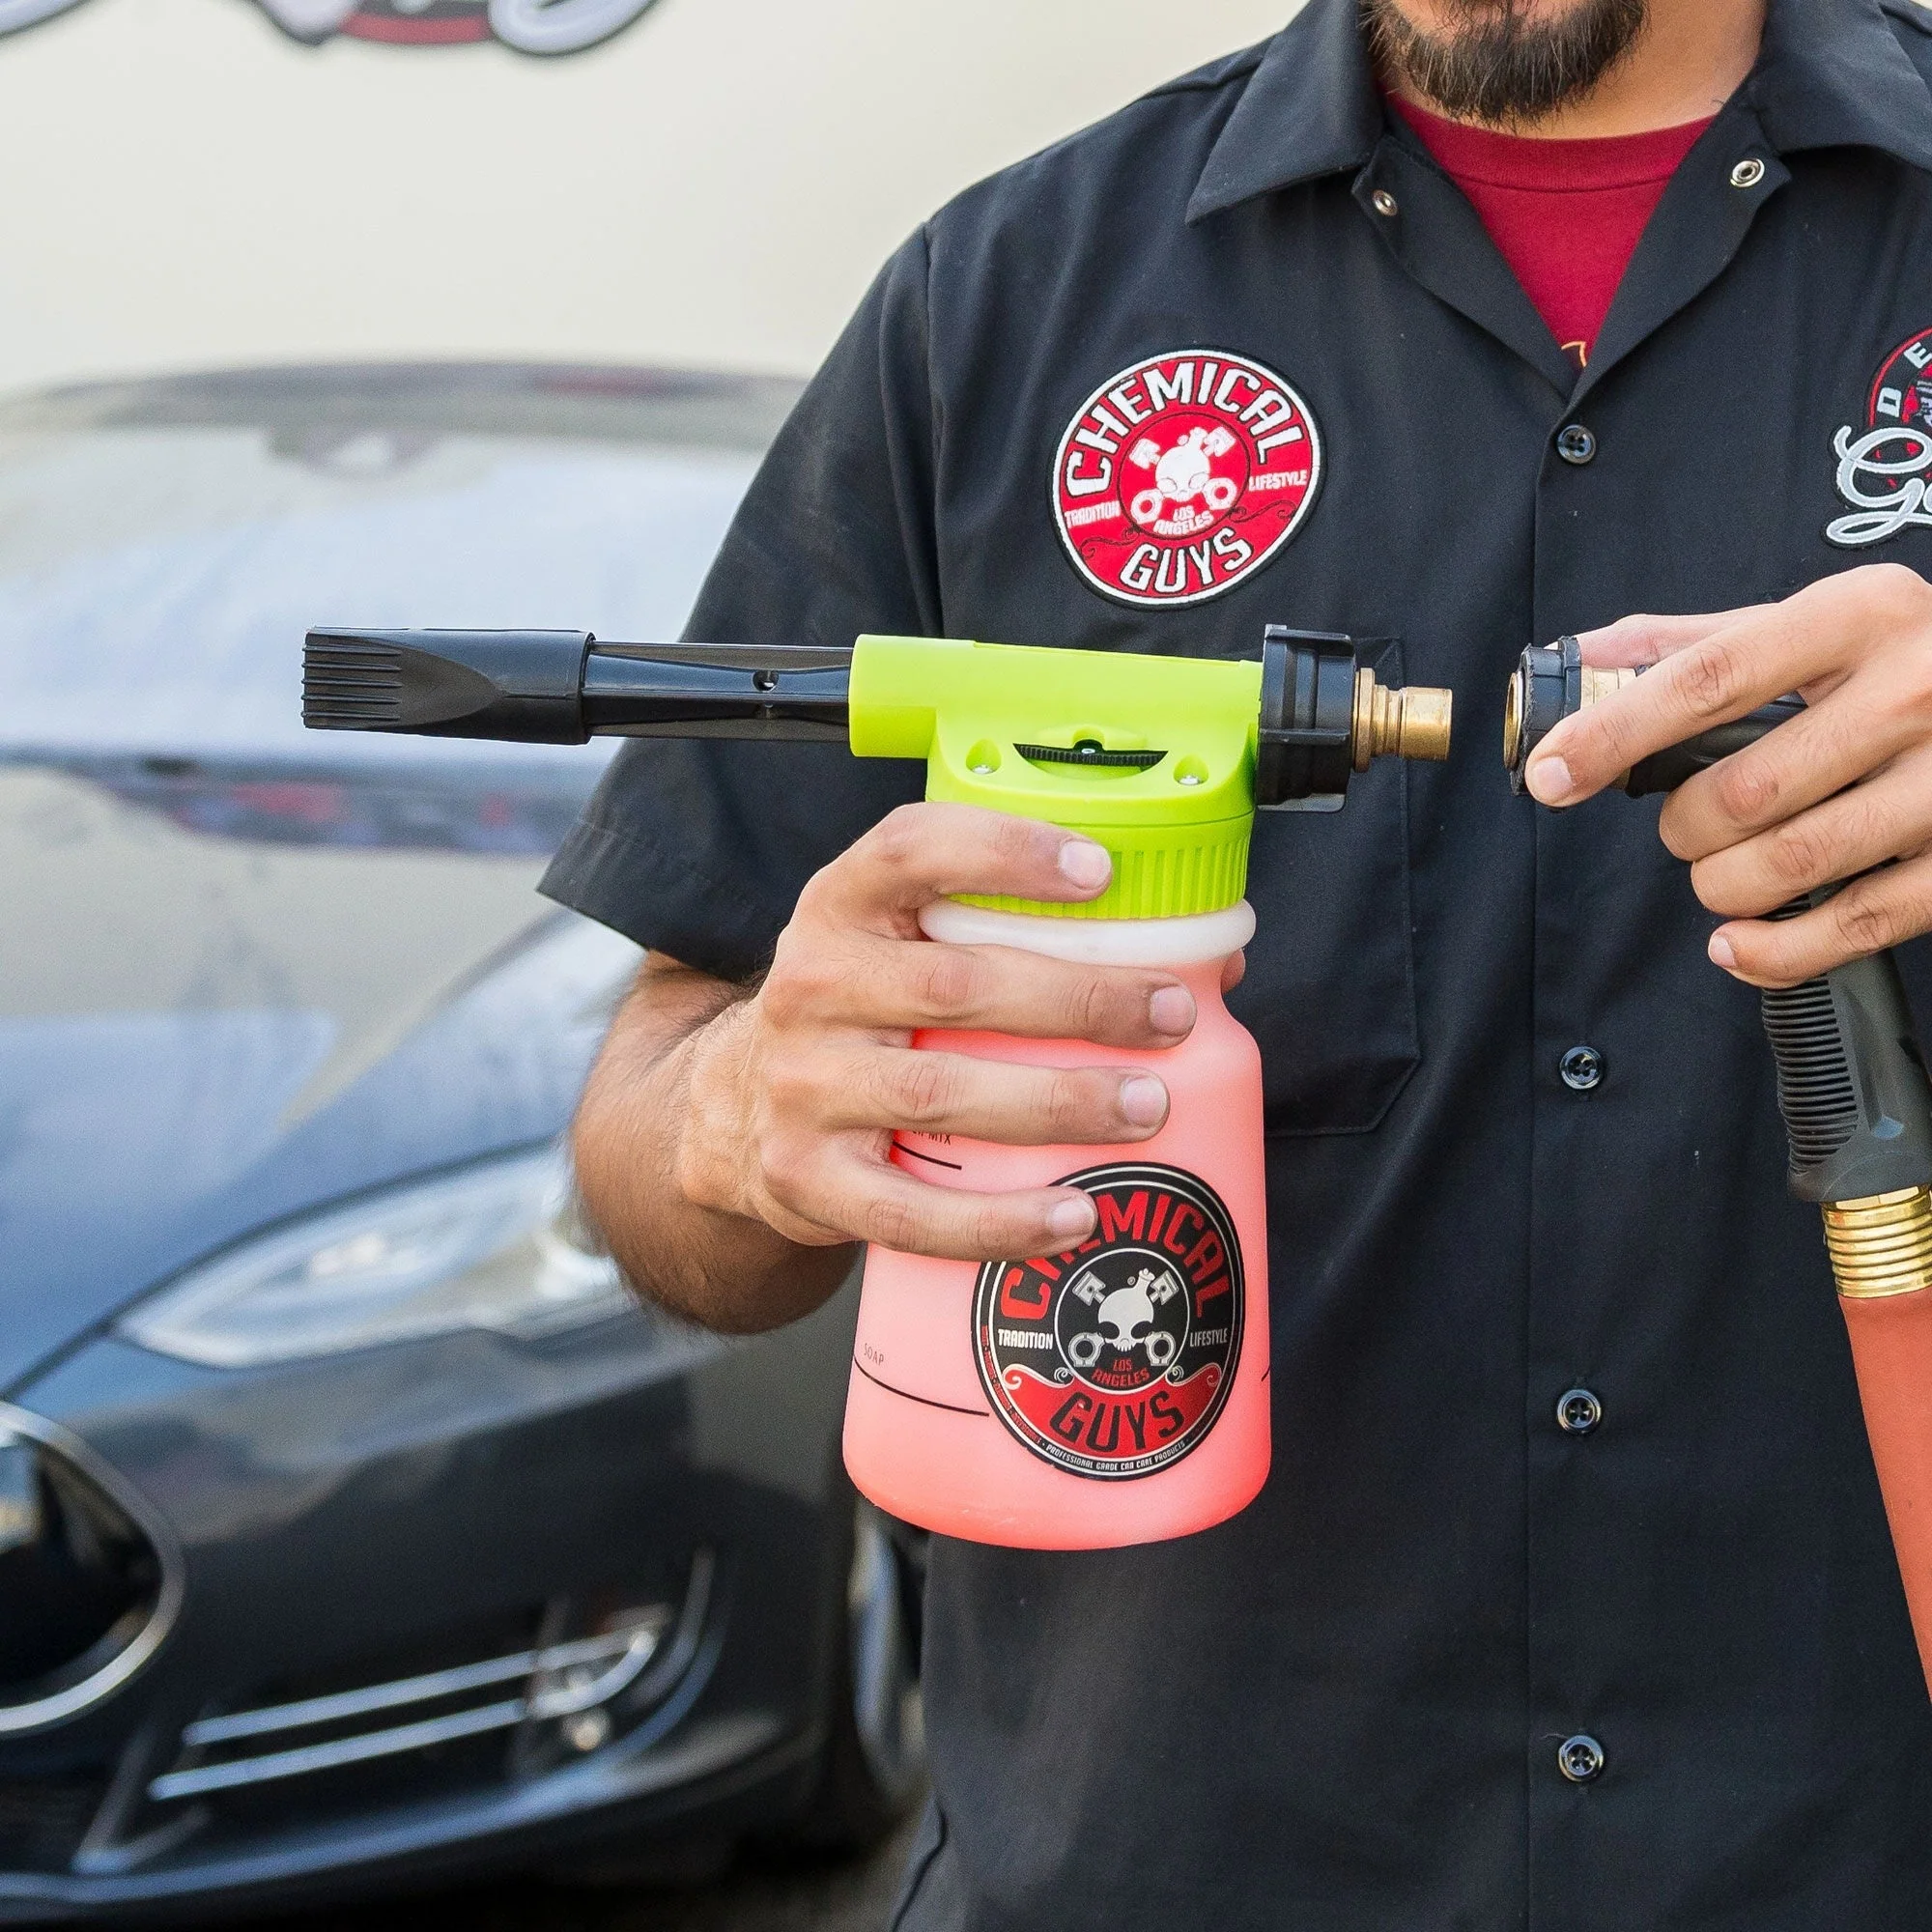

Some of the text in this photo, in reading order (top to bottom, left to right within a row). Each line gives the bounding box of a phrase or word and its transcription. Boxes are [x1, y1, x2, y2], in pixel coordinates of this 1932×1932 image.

[1065, 361, 1303, 497] CHEMICAL
[1248, 469, 1308, 492] LIFESTYLE
[1065, 500, 1121, 528] TRADITION
[1153, 511, 1214, 535] ANGELES
[1173, 505, 1195, 520] LOS
[1120, 527, 1253, 593] GUYS
[1000, 1190, 1230, 1321] CMICAL
[998, 1328, 1054, 1350] TRADITION
[1189, 1328, 1228, 1348] LIFESTYLE
[864, 1342, 885, 1365] SOAP
[1113, 1358, 1133, 1372] LOS
[1092, 1367, 1151, 1386] ANGELES
[1049, 1390, 1186, 1451] GUYS
[1045, 1444, 1094, 1469] PROFESSIONAL
[1154, 1441, 1185, 1463] PRODUCTS
